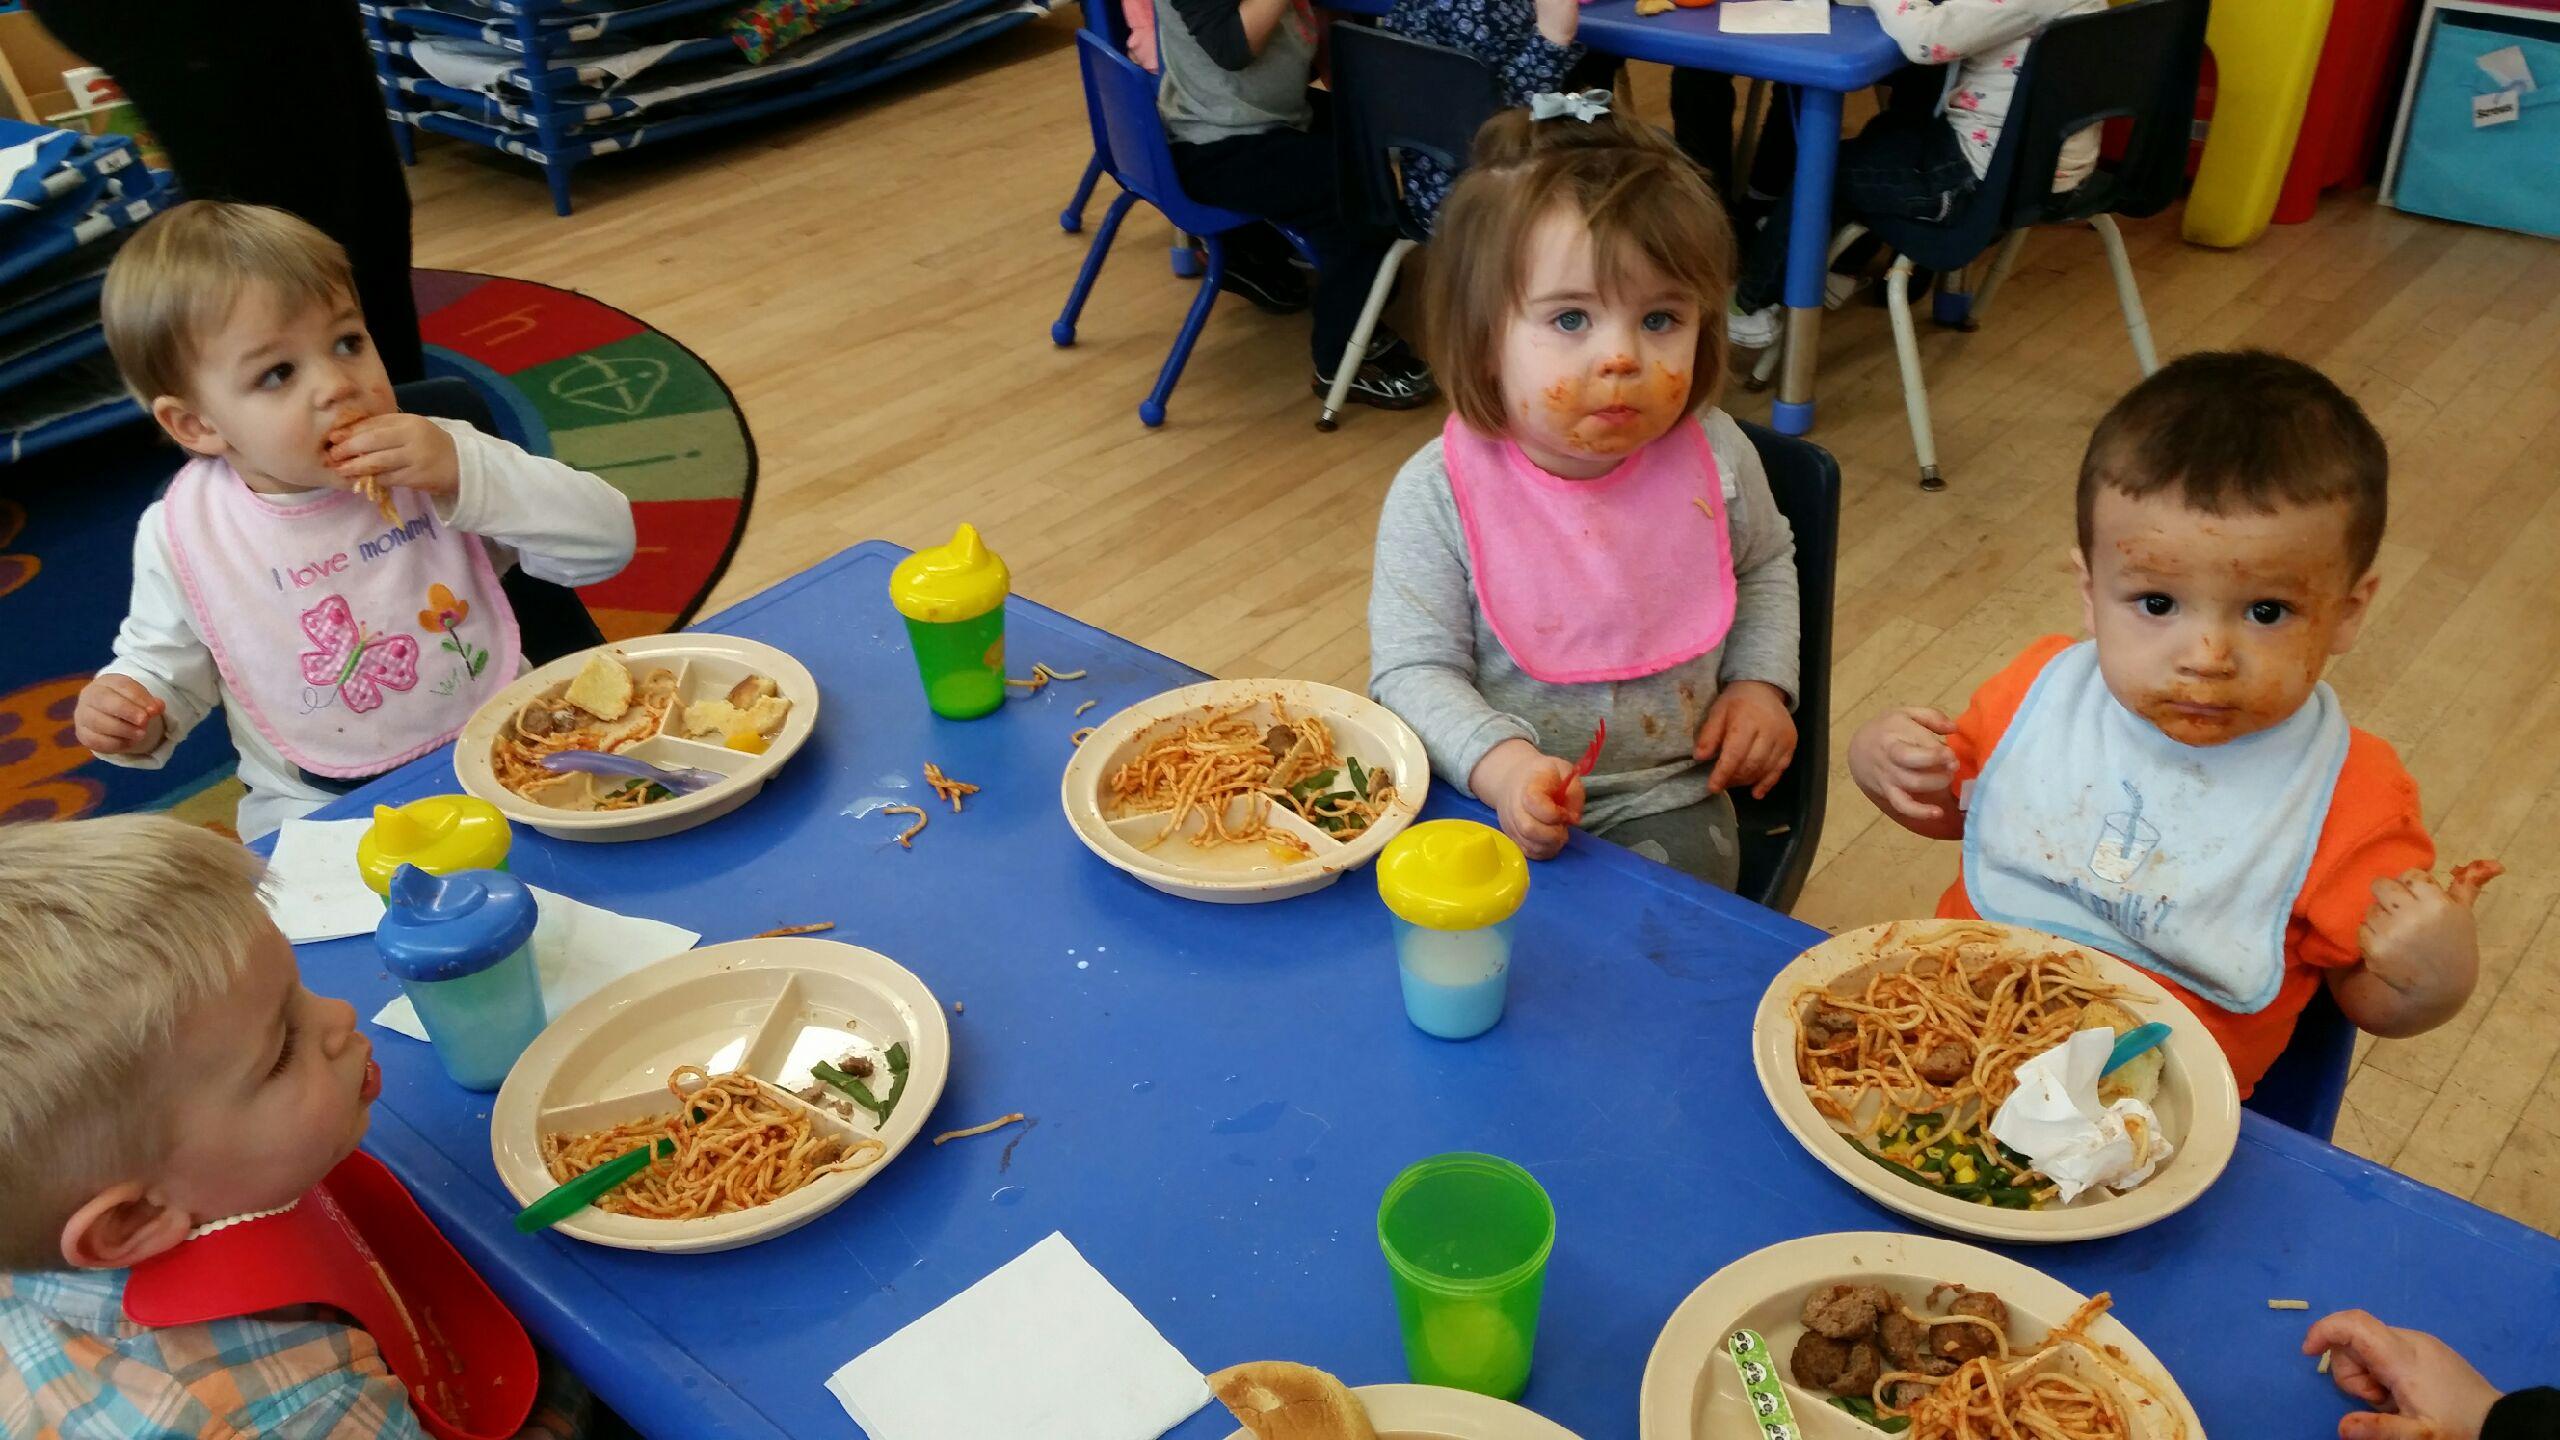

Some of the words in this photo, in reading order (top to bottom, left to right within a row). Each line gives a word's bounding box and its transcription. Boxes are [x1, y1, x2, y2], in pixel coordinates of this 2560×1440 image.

[271, 567, 284, 592] I
[287, 552, 349, 590] love
[359, 513, 435, 562] mommy
